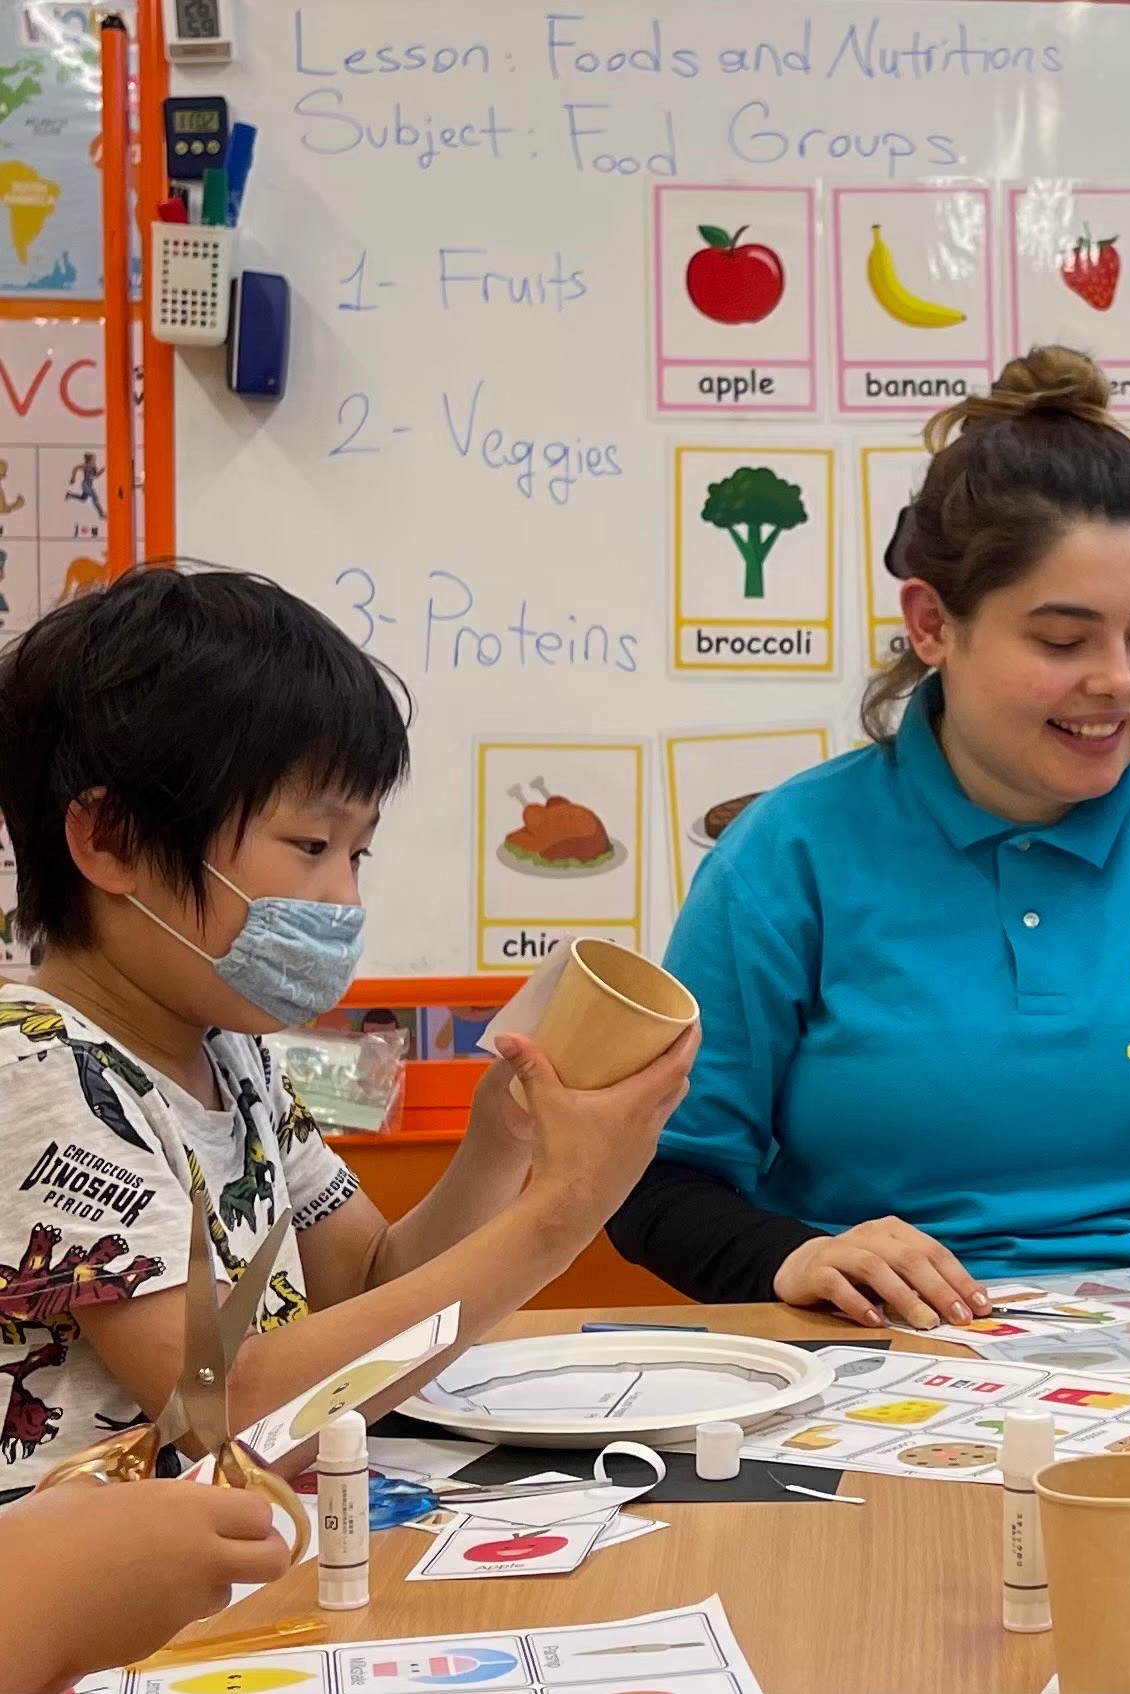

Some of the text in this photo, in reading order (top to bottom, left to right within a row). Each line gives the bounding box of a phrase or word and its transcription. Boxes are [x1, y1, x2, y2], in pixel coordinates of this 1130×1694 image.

[547, 14, 699, 79] Foods
[720, 20, 810, 76] and
[827, 17, 1064, 79] Nutritions
[563, 104, 677, 177] Food
[727, 100, 958, 177] Groups
[338, 249, 588, 312] 1- Fruits
[698, 372, 775, 400] apple
[865, 373, 968, 399] banana
[328, 380, 623, 504] 2- Veggies
[424, 569, 638, 673] Proteins
[696, 629, 812, 657] broccoli
[19, 1140, 156, 1228] DINOSAUR
[63, 1144, 144, 1188] CRETACEOUS
[42, 1190, 104, 1222] PERIOD
[473, 1562, 526, 1571] Apple
